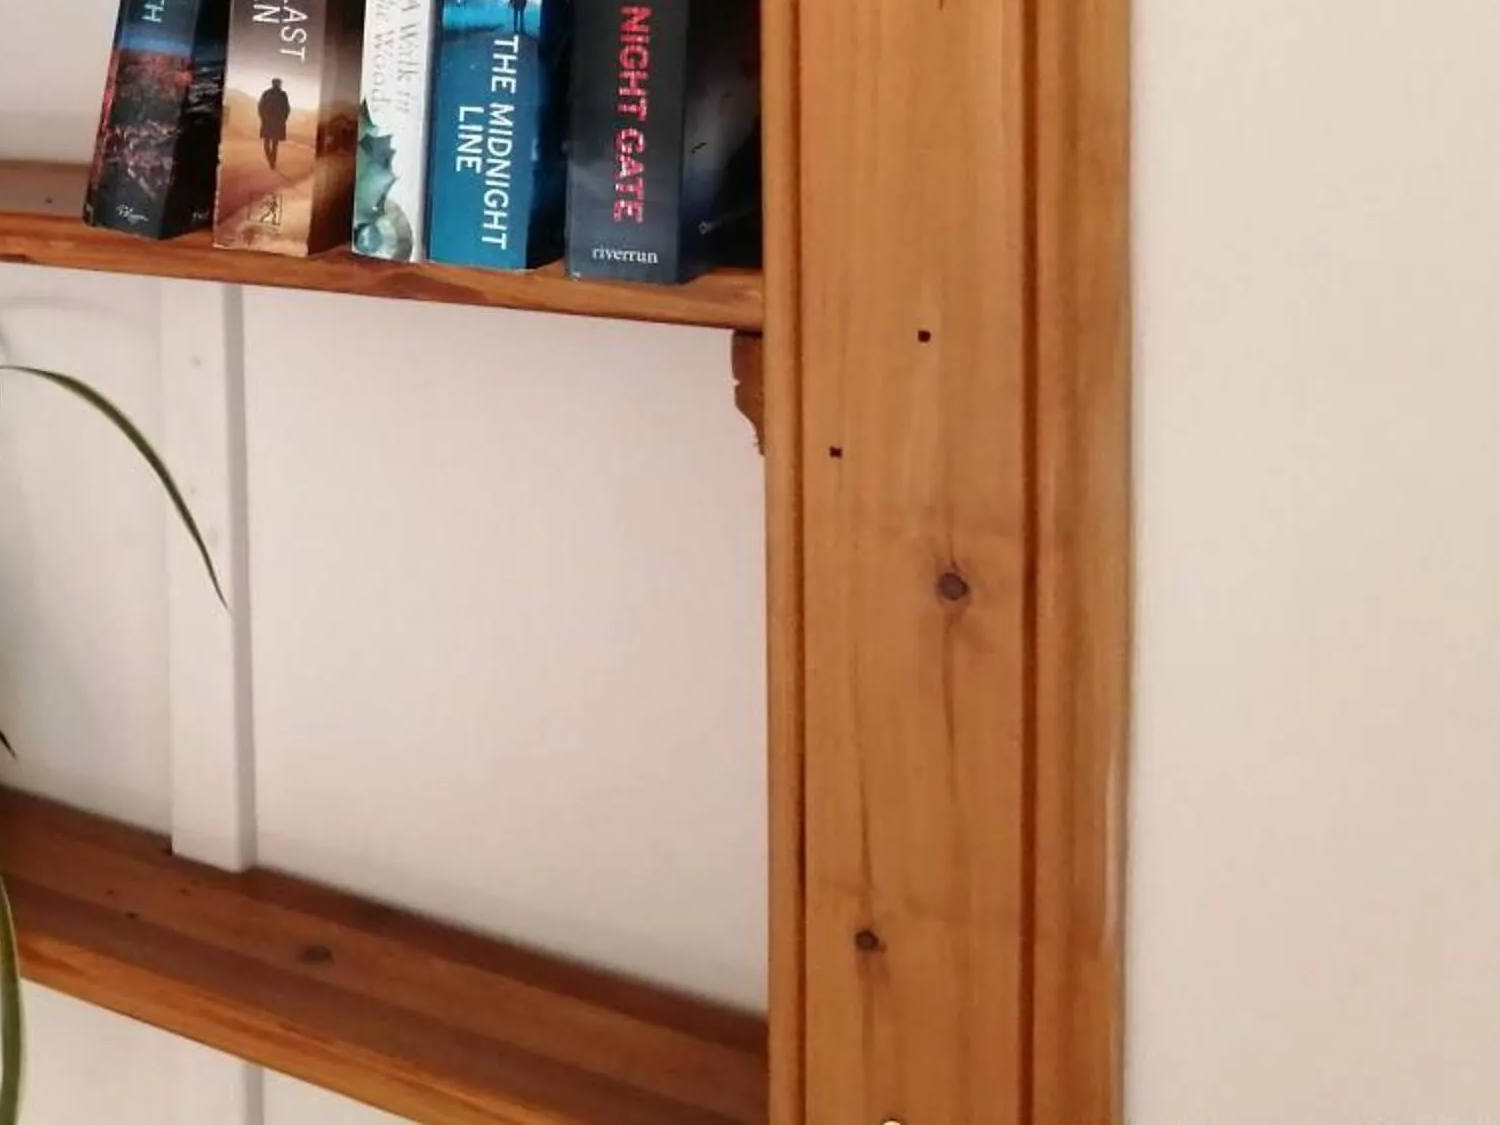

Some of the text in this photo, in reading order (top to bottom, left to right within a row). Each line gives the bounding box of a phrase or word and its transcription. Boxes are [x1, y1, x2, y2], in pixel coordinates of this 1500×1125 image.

[617, 7, 653, 121] NIGHT
[456, 106, 485, 173] LINE
[481, 35, 519, 250] THE MIDNIGHT
[612, 127, 647, 223] GATE
[592, 245, 659, 265] riverrun
